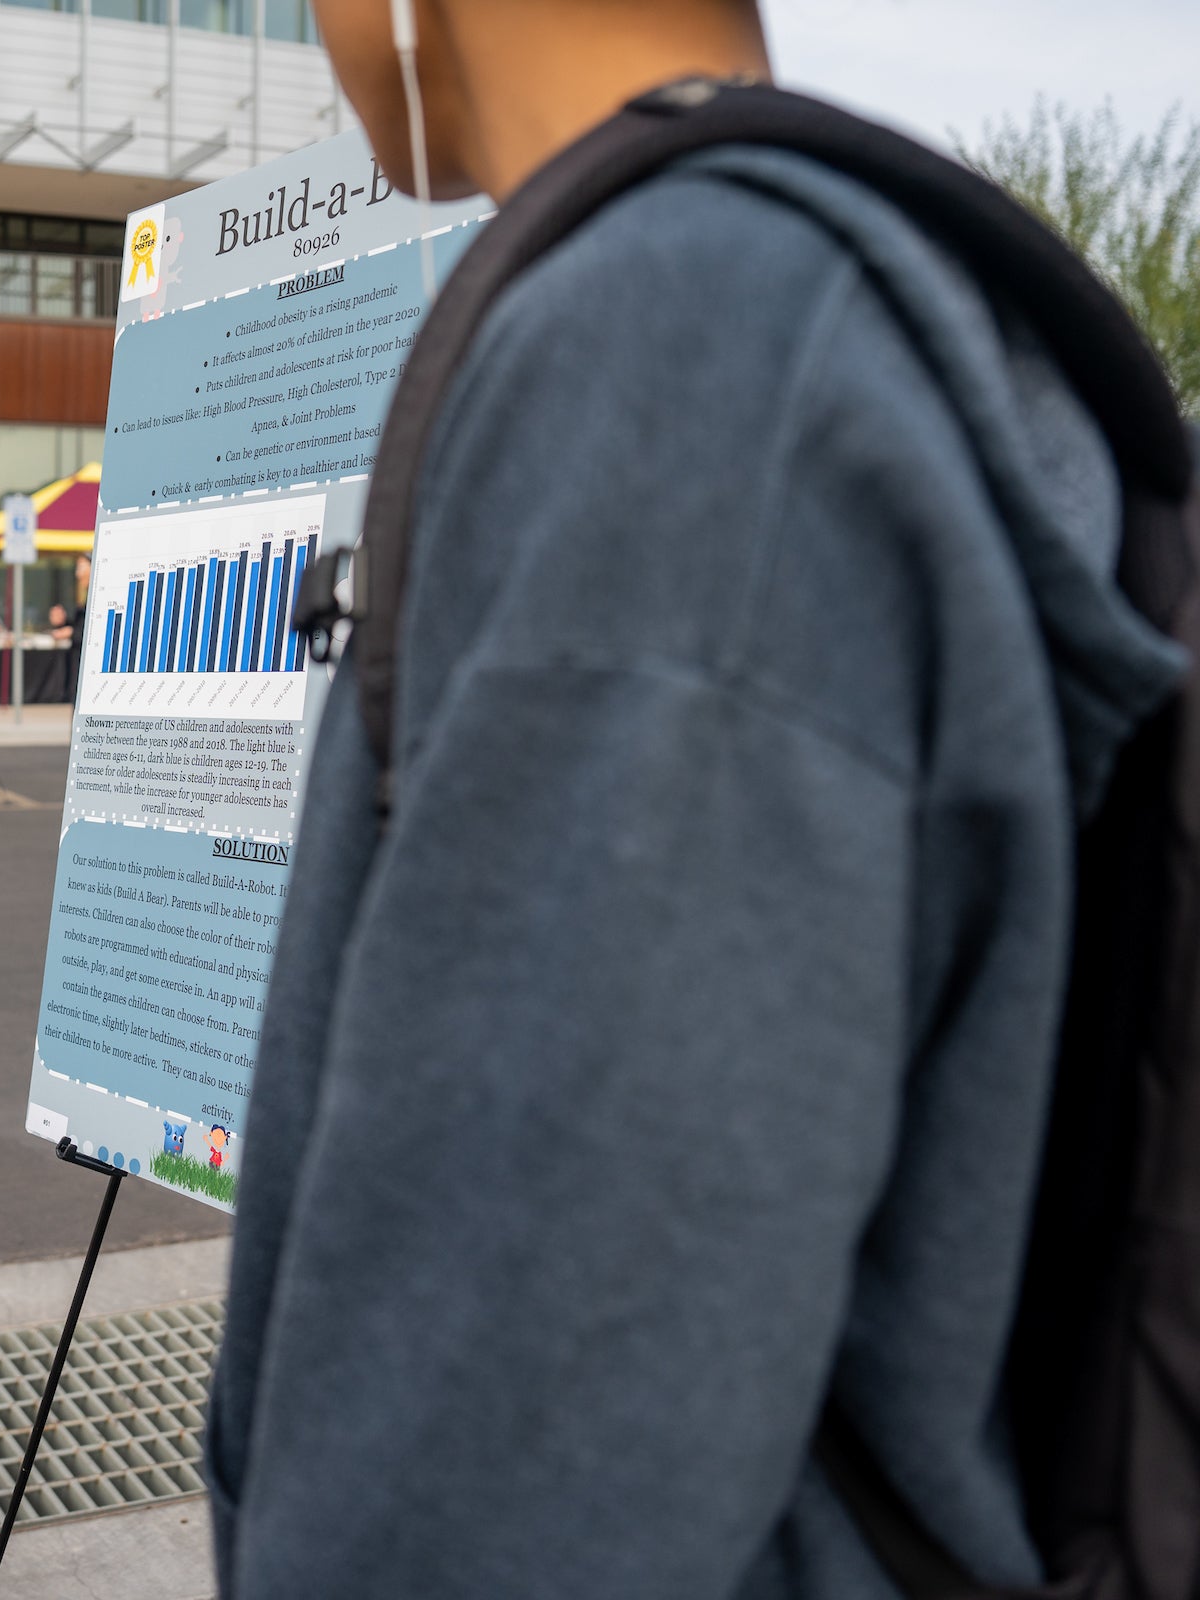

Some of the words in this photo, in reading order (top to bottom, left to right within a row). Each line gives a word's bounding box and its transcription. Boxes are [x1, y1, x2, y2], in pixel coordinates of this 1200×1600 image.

[134, 239, 155, 251] POSTER
[140, 233, 151, 242] TOP
[293, 225, 341, 257] 80926
[277, 266, 345, 299] PROBLEM
[234, 314, 277, 337] Childhood
[277, 308, 309, 326] obesity
[309, 307, 317, 318] is
[318, 305, 324, 315] a
[325, 298, 351, 313] rising
[352, 282, 398, 310] pandemic
[212, 355, 219, 367] It
[220, 350, 246, 365] affects
[246, 342, 275, 359] almost
[276, 336, 295, 352] 20%
[296, 332, 307, 347] of
[306, 326, 343, 344] children
[344, 324, 354, 334] in
[356, 317, 371, 332] the
[371, 313, 394, 331] year
[394, 306, 421, 322] 2020
[206, 380, 223, 393] Puts
[224, 372, 257, 389] children
[258, 365, 275, 381] and
[275, 356, 325, 377] adolescents
[325, 353, 335, 366] at
[337, 347, 355, 363] risk
[355, 345, 370, 359] for
[370, 341, 394, 358] poor
[121, 422, 136, 433] Can
[136, 416, 152, 431] lead
[152, 418, 161, 427] to
[161, 413, 184, 426] issues
[184, 408, 201, 421] like:
[202, 402, 222, 419] High
[223, 396, 247, 414] Blood
[247, 392, 285, 408] Pressure,
[287, 384, 308, 401] High
[309, 372, 362, 395] Cholesterol,
[364, 370, 388, 386] Type
[389, 367, 396, 378] 2
[250, 419, 279, 435] Apnea,
[281, 414, 289, 427] &
[289, 410, 313, 426] Joint
[314, 403, 356, 421] Problems
[225, 450, 241, 462] Can
[242, 447, 253, 459] be
[253, 441, 284, 461] genetic
[284, 442, 295, 452] or
[295, 430, 352, 450] environment
[354, 423, 380, 440] based
[161, 482, 184, 498] Quick
[184, 481, 191, 493] &
[193, 477, 214, 492] early
[214, 472, 256, 489] combating
[257, 473, 265, 482] is
[266, 468, 282, 483] key
[282, 467, 292, 478] to
[292, 467, 298, 477] a
[299, 459, 340, 476] healthier
[340, 454, 358, 470] and
[84, 716, 114, 728] Shown:
[114, 719, 154, 733] percentage
[154, 718, 164, 730] of
[164, 719, 176, 731] US
[176, 719, 208, 732] children
[208, 720, 225, 733] and
[225, 720, 273, 735] adolescents
[274, 722, 293, 735] with
[80, 731, 105, 746] obesity
[105, 732, 135, 746] between
[135, 734, 148, 746] the
[147, 738, 169, 749] years
[169, 736, 189, 750] 1988
[189, 736, 205, 749] and
[205, 738, 227, 750] 2018.
[229, 738, 246, 752] The
[245, 738, 266, 756] light
[267, 739, 286, 754] blue
[287, 744, 295, 754] is
[83, 747, 111, 760] children
[112, 752, 128, 764] ages
[128, 750, 146, 764] 6-11,
[147, 751, 165, 764] dark
[165, 752, 182, 765] blue
[182, 756, 190, 766] is
[190, 753, 223, 768] children
[224, 759, 243, 772] ages
[244, 760, 268, 773] 12-19.
[270, 757, 287, 772] The
[76, 766, 104, 776] increase
[104, 764, 116, 777] for
[116, 765, 135, 778] older
[135, 767, 178, 782] adolescents
[179, 773, 186, 783] is
[186, 771, 218, 788] steadily
[218, 776, 261, 791] increasing
[260, 779, 270, 789] in
[271, 777, 292, 791] each
[76, 778, 112, 793] increment,
[113, 781, 133, 794] while
[133, 783, 146, 796] the
[146, 787, 178, 799] increase
[178, 786, 190, 800] for
[189, 791, 223, 806] younger
[223, 790, 272, 808] adolescents
[272, 794, 288, 809] has
[140, 801, 167, 815] overall
[167, 802, 205, 819] increased.
[213, 838, 289, 865] SOLUTION
[72, 853, 87, 866] Our
[87, 855, 117, 871] solution
[118, 861, 127, 872] to
[127, 860, 143, 875] this
[142, 864, 176, 880] problem
[177, 871, 185, 882] is
[185, 870, 211, 886] called
[211, 873, 277, 896] Build-A-Robot.
[63, 928, 87, 943] robots
[87, 935, 100, 946] are
[99, 938, 149, 957] programmed
[150, 946, 168, 961] with
[168, 950, 217, 972] educational
[217, 962, 235, 976] and
[234, 966, 272, 986] physical
[62, 981, 89, 995] contain
[90, 984, 103, 999] the
[102, 991, 127, 1005] games
[127, 994, 160, 1014] children
[160, 1006, 175, 1018] can
[176, 1007, 205, 1026] choose
[206, 1014, 229, 1033] from.
[44, 1023, 62, 1039] their
[61, 1029, 91, 1049] children
[92, 1039, 101, 1051] to
[101, 1040, 111, 1054] be
[111, 1047, 132, 1061] more
[132, 1053, 158, 1069] active.
[161, 1058, 182, 1079] They
[182, 1068, 198, 1082] can
[198, 1071, 217, 1087] also
[217, 1079, 233, 1093] use
[234, 1080, 252, 1099] this
[201, 1103, 235, 1124] activity.
